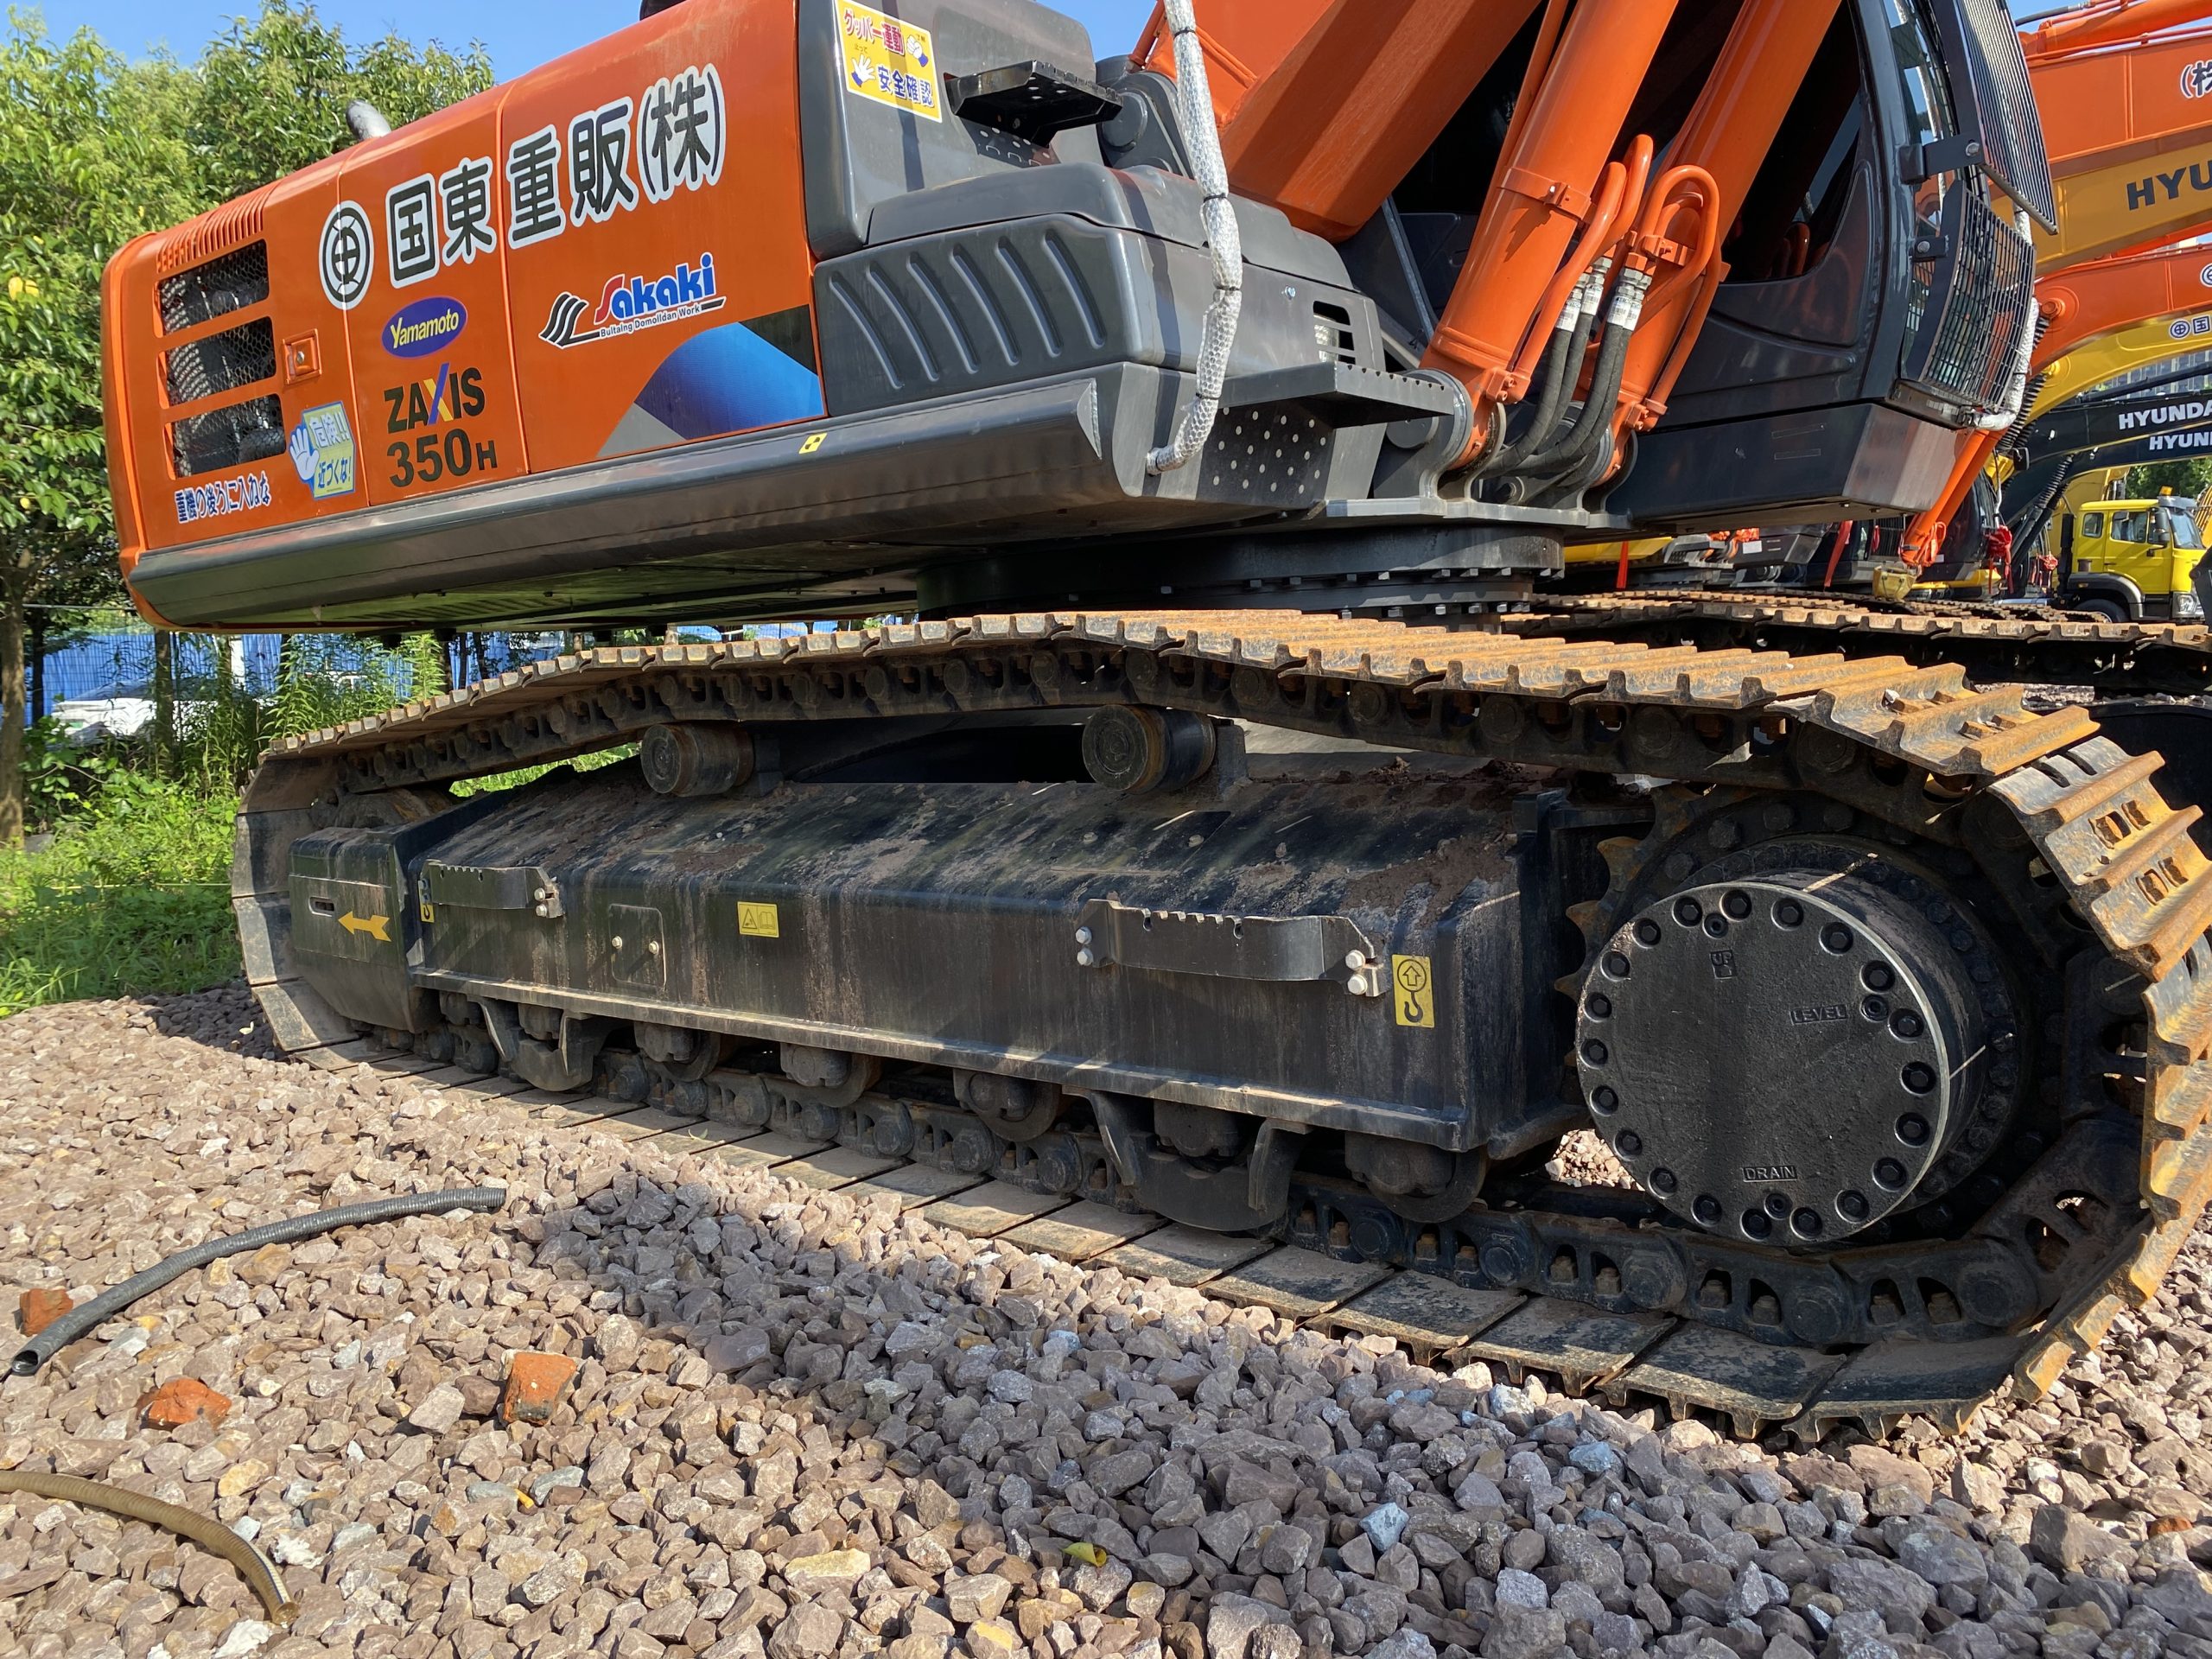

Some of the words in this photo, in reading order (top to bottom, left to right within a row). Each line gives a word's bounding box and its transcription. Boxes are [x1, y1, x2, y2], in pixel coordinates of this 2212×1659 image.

[877, 65, 934, 107] 安全確認
[594, 253, 716, 324] Sakaki
[678, 305, 700, 318] Work
[390, 308, 460, 349] Yamamoto
[384, 362, 486, 434] ZAXIS
[2149, 432, 2212, 451] HYUN
[1793, 1005, 1846, 1022] LEVEL
[1745, 1166, 1796, 1180] DRAIN
